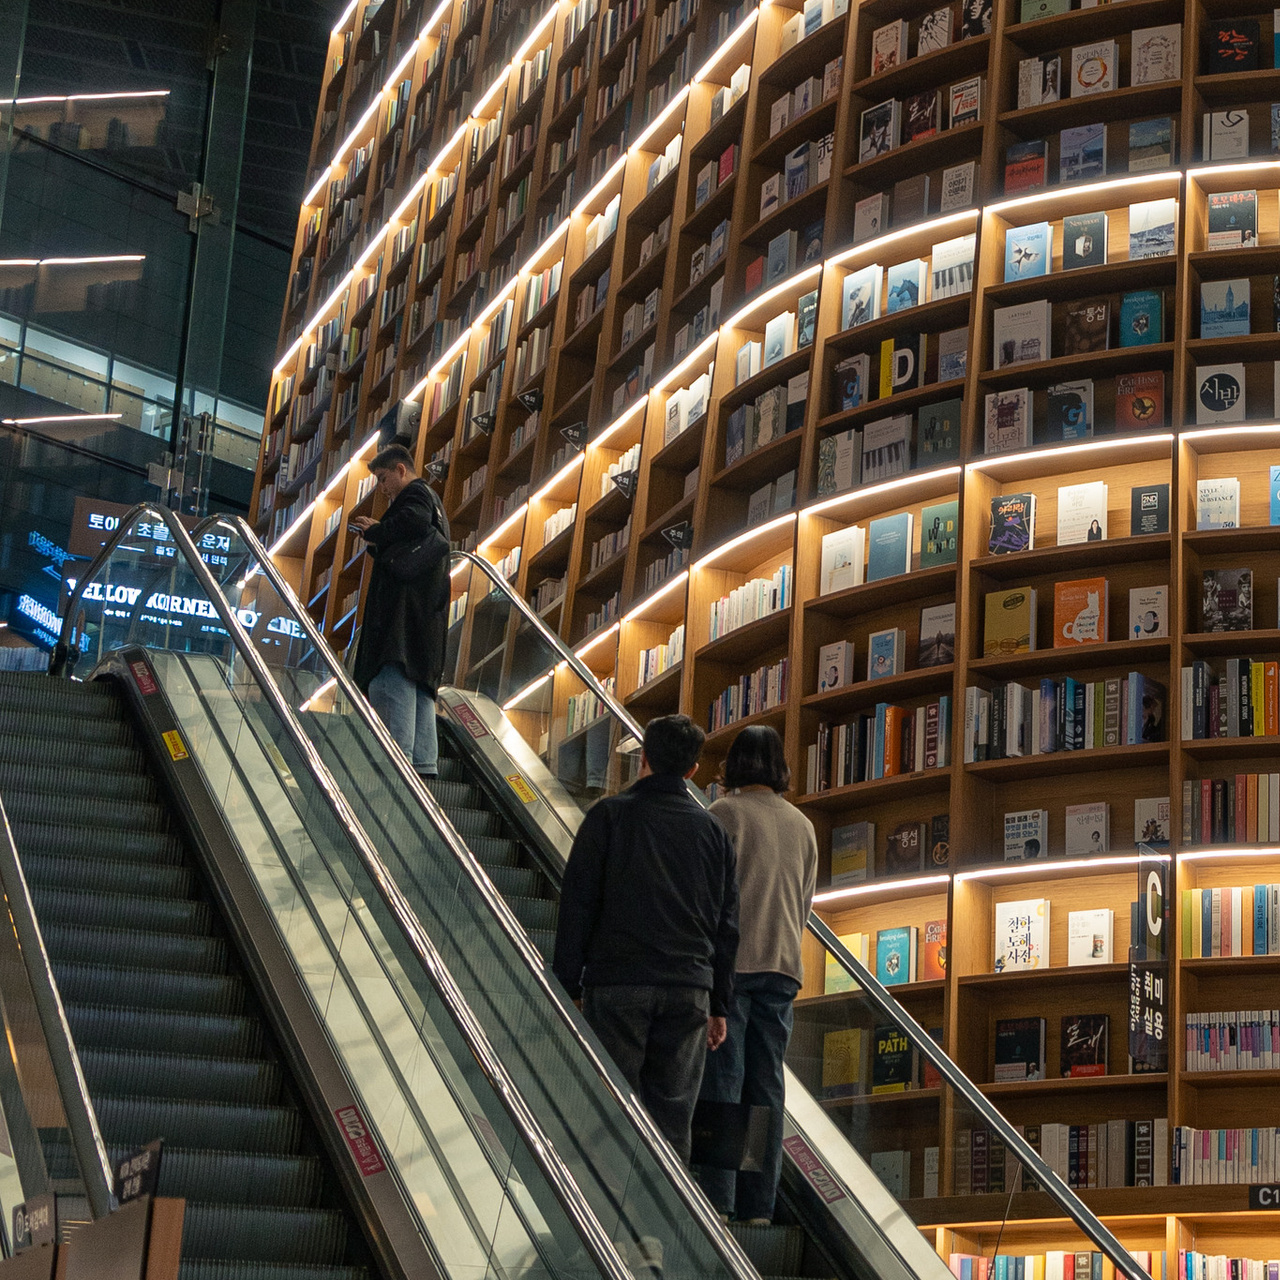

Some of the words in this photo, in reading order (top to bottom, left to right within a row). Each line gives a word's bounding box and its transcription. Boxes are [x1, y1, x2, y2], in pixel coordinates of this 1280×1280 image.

[1200, 375, 1240, 408] 시밤
[1199, 487, 1218, 495] STYLE
[1199, 494, 1235, 504] SUBSTANCE
[1222, 521, 1235, 529] 50
[1146, 870, 1162, 936] C
[878, 1036, 908, 1056] PATH
